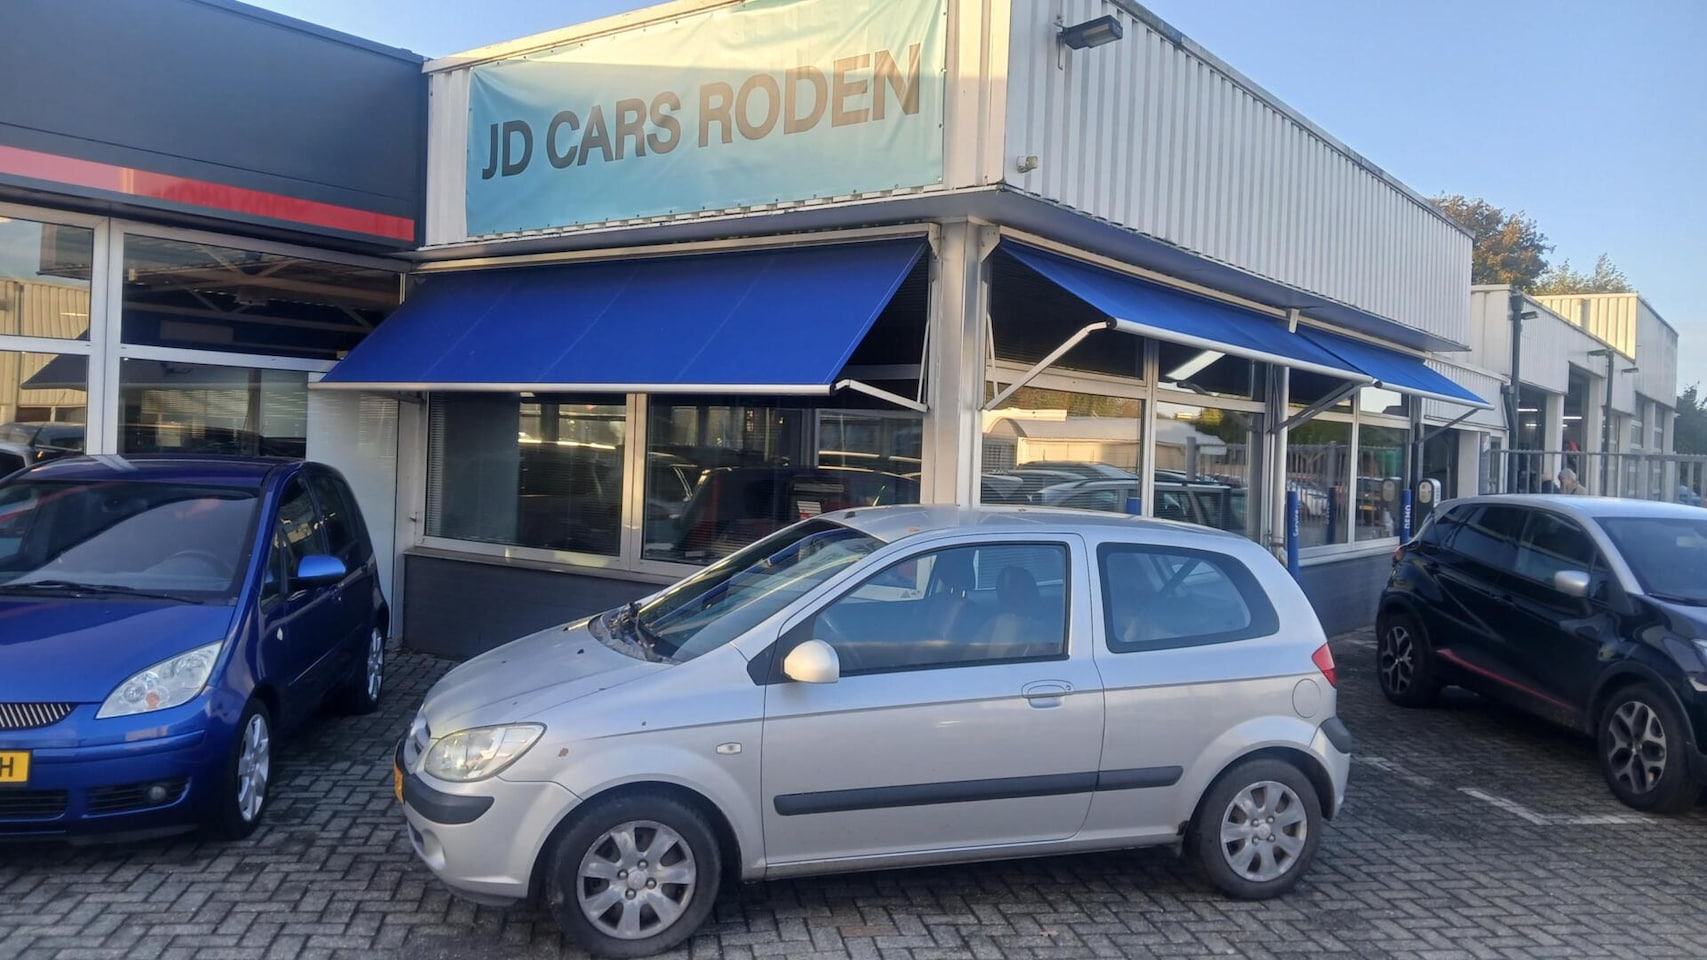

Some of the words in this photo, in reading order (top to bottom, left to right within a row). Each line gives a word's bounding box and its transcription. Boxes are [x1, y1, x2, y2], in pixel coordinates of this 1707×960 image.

[482, 119, 533, 180] JD
[546, 91, 681, 168] CARS
[698, 43, 921, 148] RODEN
